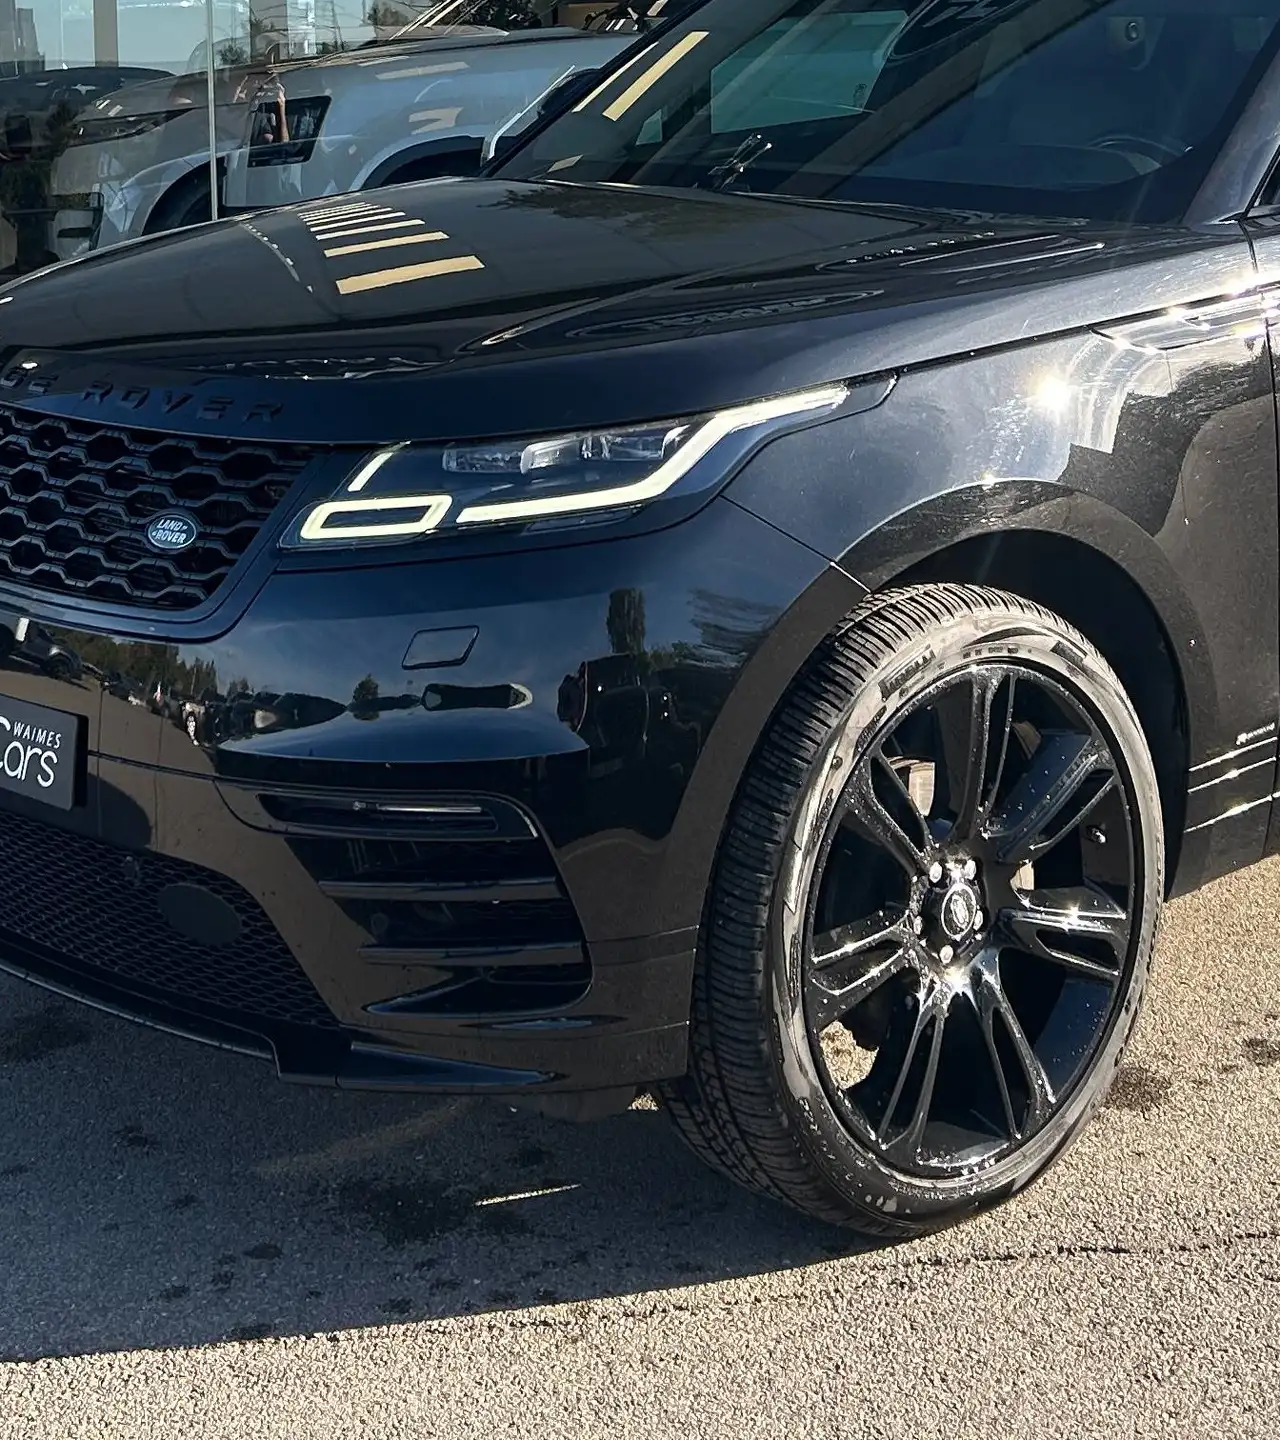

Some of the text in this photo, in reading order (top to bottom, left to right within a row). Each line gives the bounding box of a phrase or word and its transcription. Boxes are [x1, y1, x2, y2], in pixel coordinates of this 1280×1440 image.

[81, 378, 284, 423] ROVER
[156, 517, 184, 531] LAND
[154, 529, 187, 544] ROVER
[13, 720, 62, 749] WAIMES
